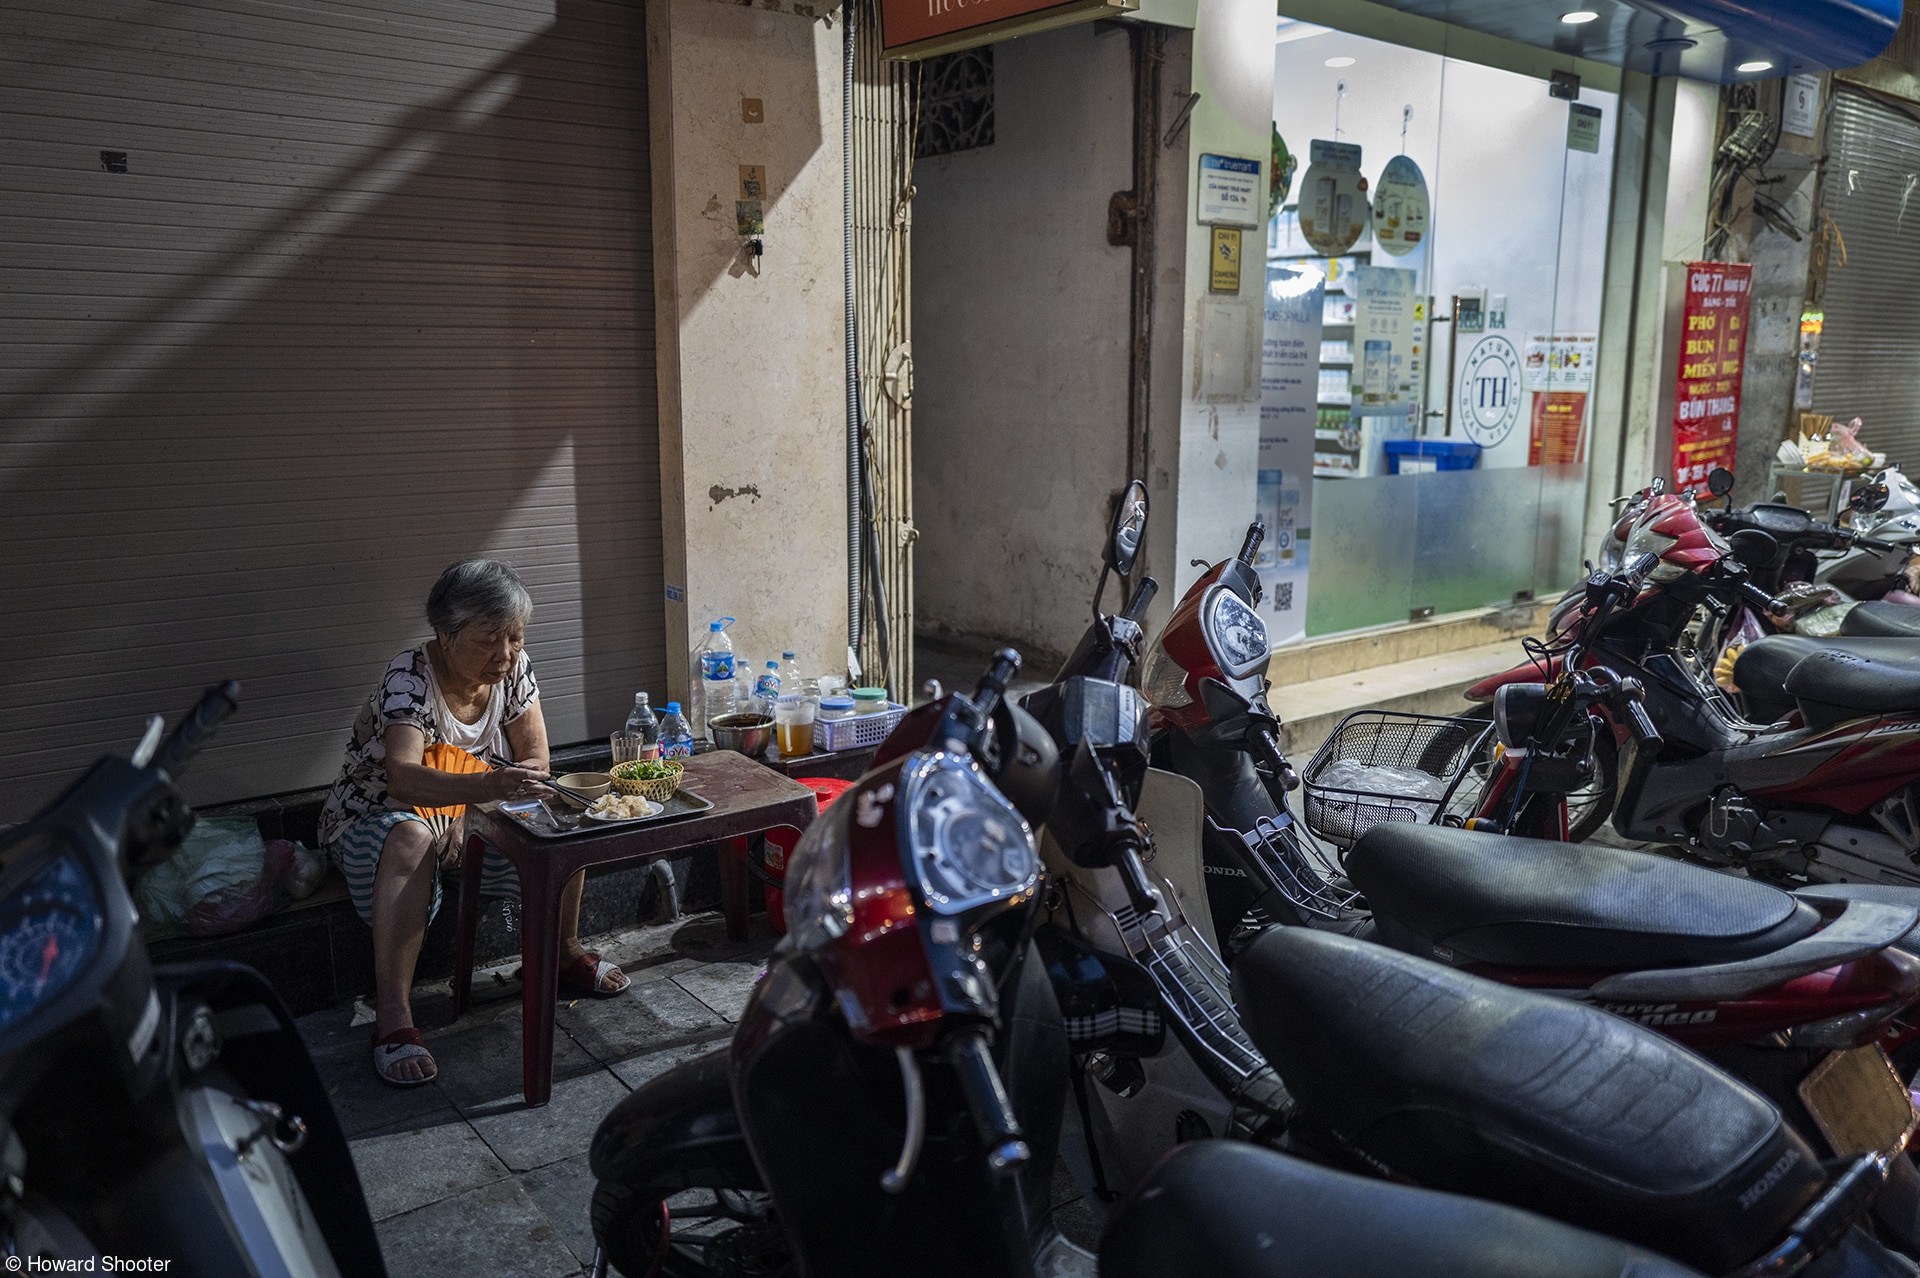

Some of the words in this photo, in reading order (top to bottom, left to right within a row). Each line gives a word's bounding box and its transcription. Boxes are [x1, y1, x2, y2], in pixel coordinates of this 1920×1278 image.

[1214, 270, 1237, 278] CAMERA
[1711, 273, 1723, 293] 77
[1489, 311, 1506, 329] RA
[1688, 310, 1717, 331] PHỞ
[1470, 341, 1516, 369] NATURE
[1685, 335, 1715, 355] BÚN
[1682, 357, 1717, 379] MIẾN
[1475, 377, 1508, 409] TH
[1679, 395, 1706, 420] BÚN
[1203, 865, 1248, 878] ONDA
[1738, 1148, 1801, 1210] HONDA
